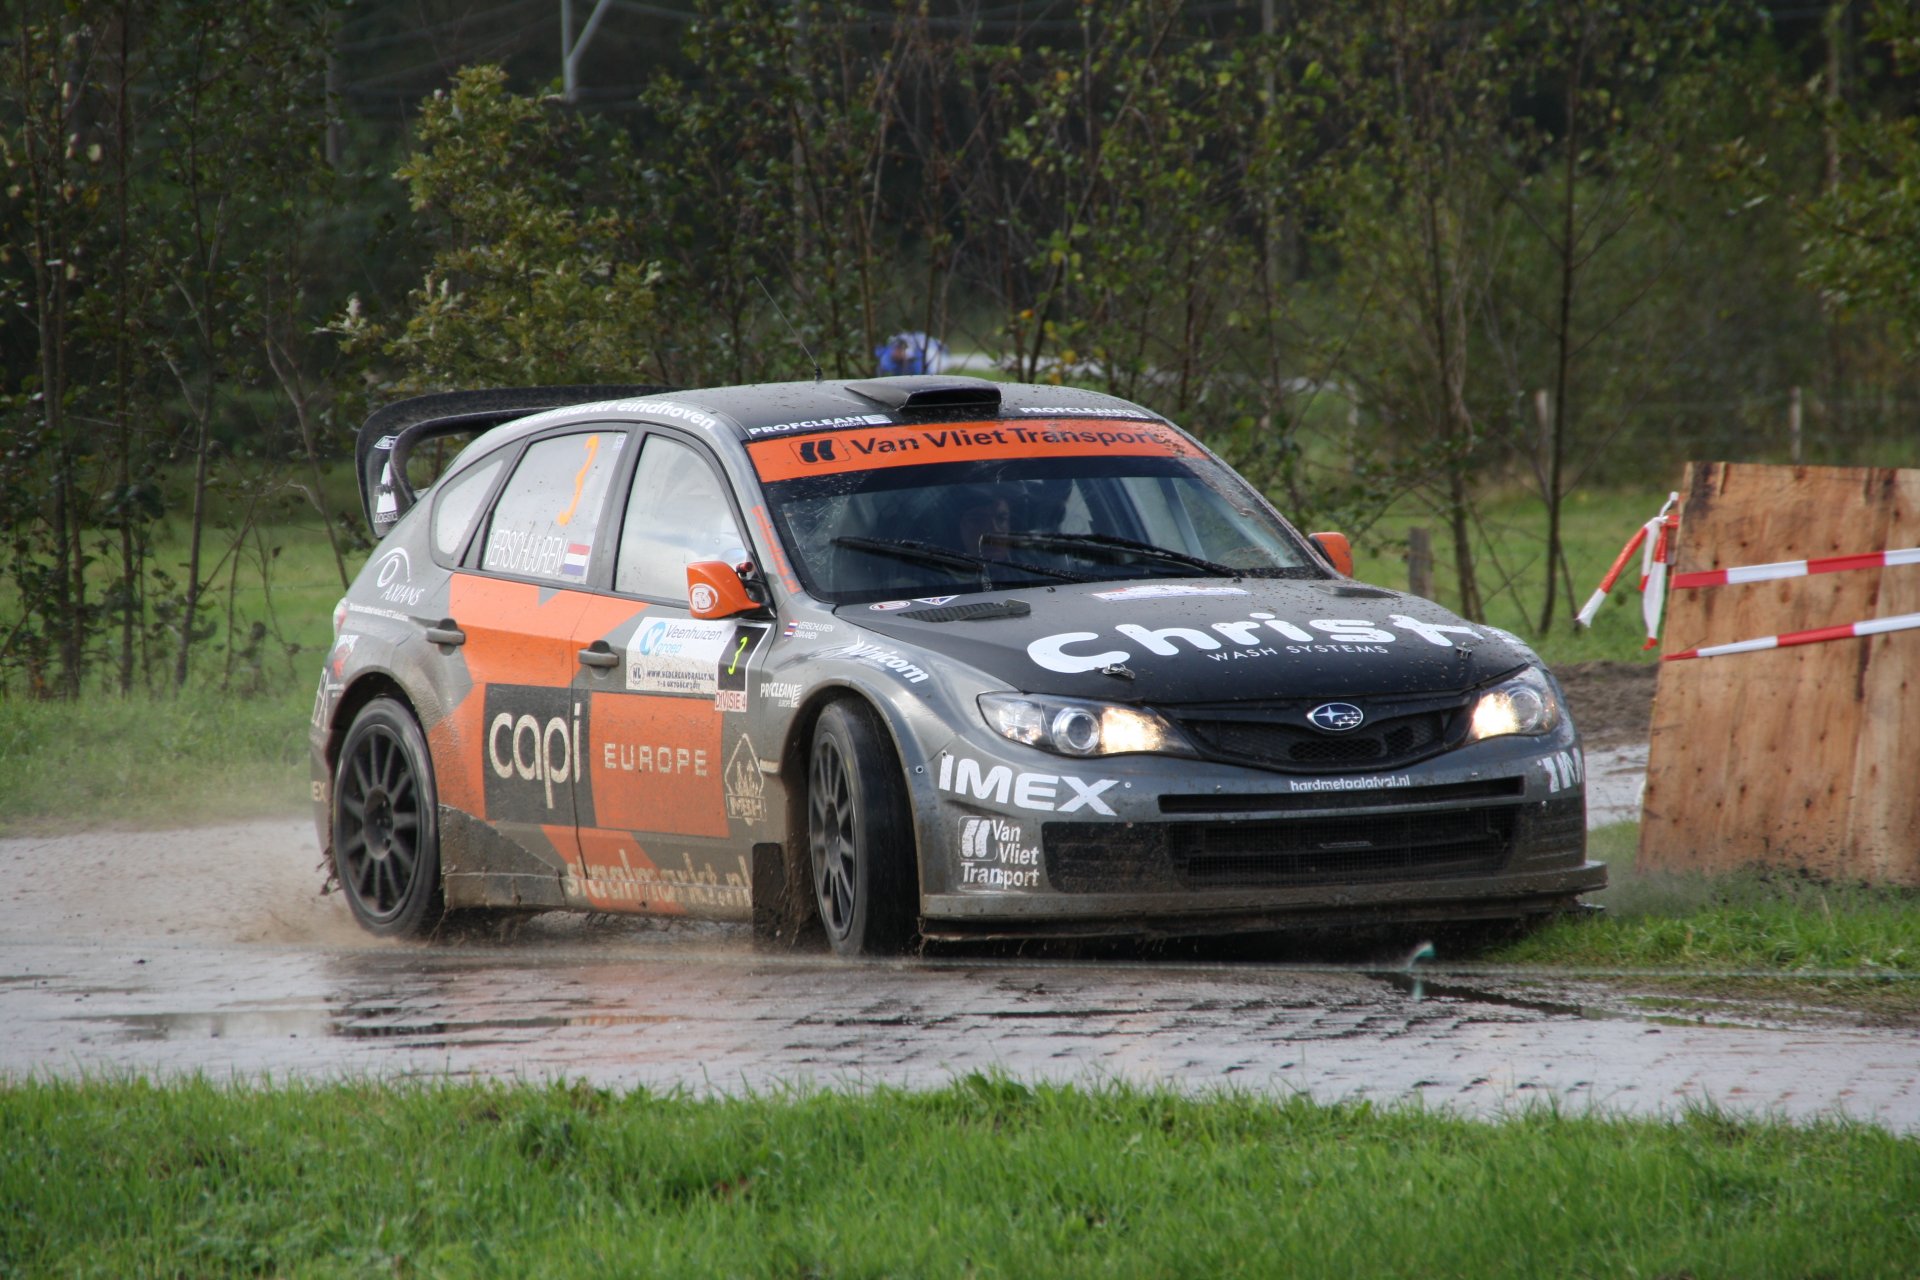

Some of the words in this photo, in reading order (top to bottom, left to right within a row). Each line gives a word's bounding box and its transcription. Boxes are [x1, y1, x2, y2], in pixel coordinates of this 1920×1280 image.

[510, 400, 616, 429] aalmarkt
[617, 400, 716, 429] eindhoven
[748, 415, 862, 435] PROFCLEAN
[851, 437, 920, 455] Van
[923, 428, 1009, 448] Vliet
[1006, 427, 1168, 447] Transport
[666, 624, 722, 641] Veenhuizen
[1027, 612, 1485, 674] Christ
[654, 642, 683, 657] groep
[1207, 647, 1278, 662] WASH
[1286, 644, 1389, 655] SYSTEMS
[716, 691, 740, 710] DIVISIE
[489, 703, 582, 809] capi
[604, 742, 708, 777] EUROPE
[938, 754, 1120, 817] IMEX
[992, 819, 1021, 843] Van
[999, 843, 1039, 866] Vliet
